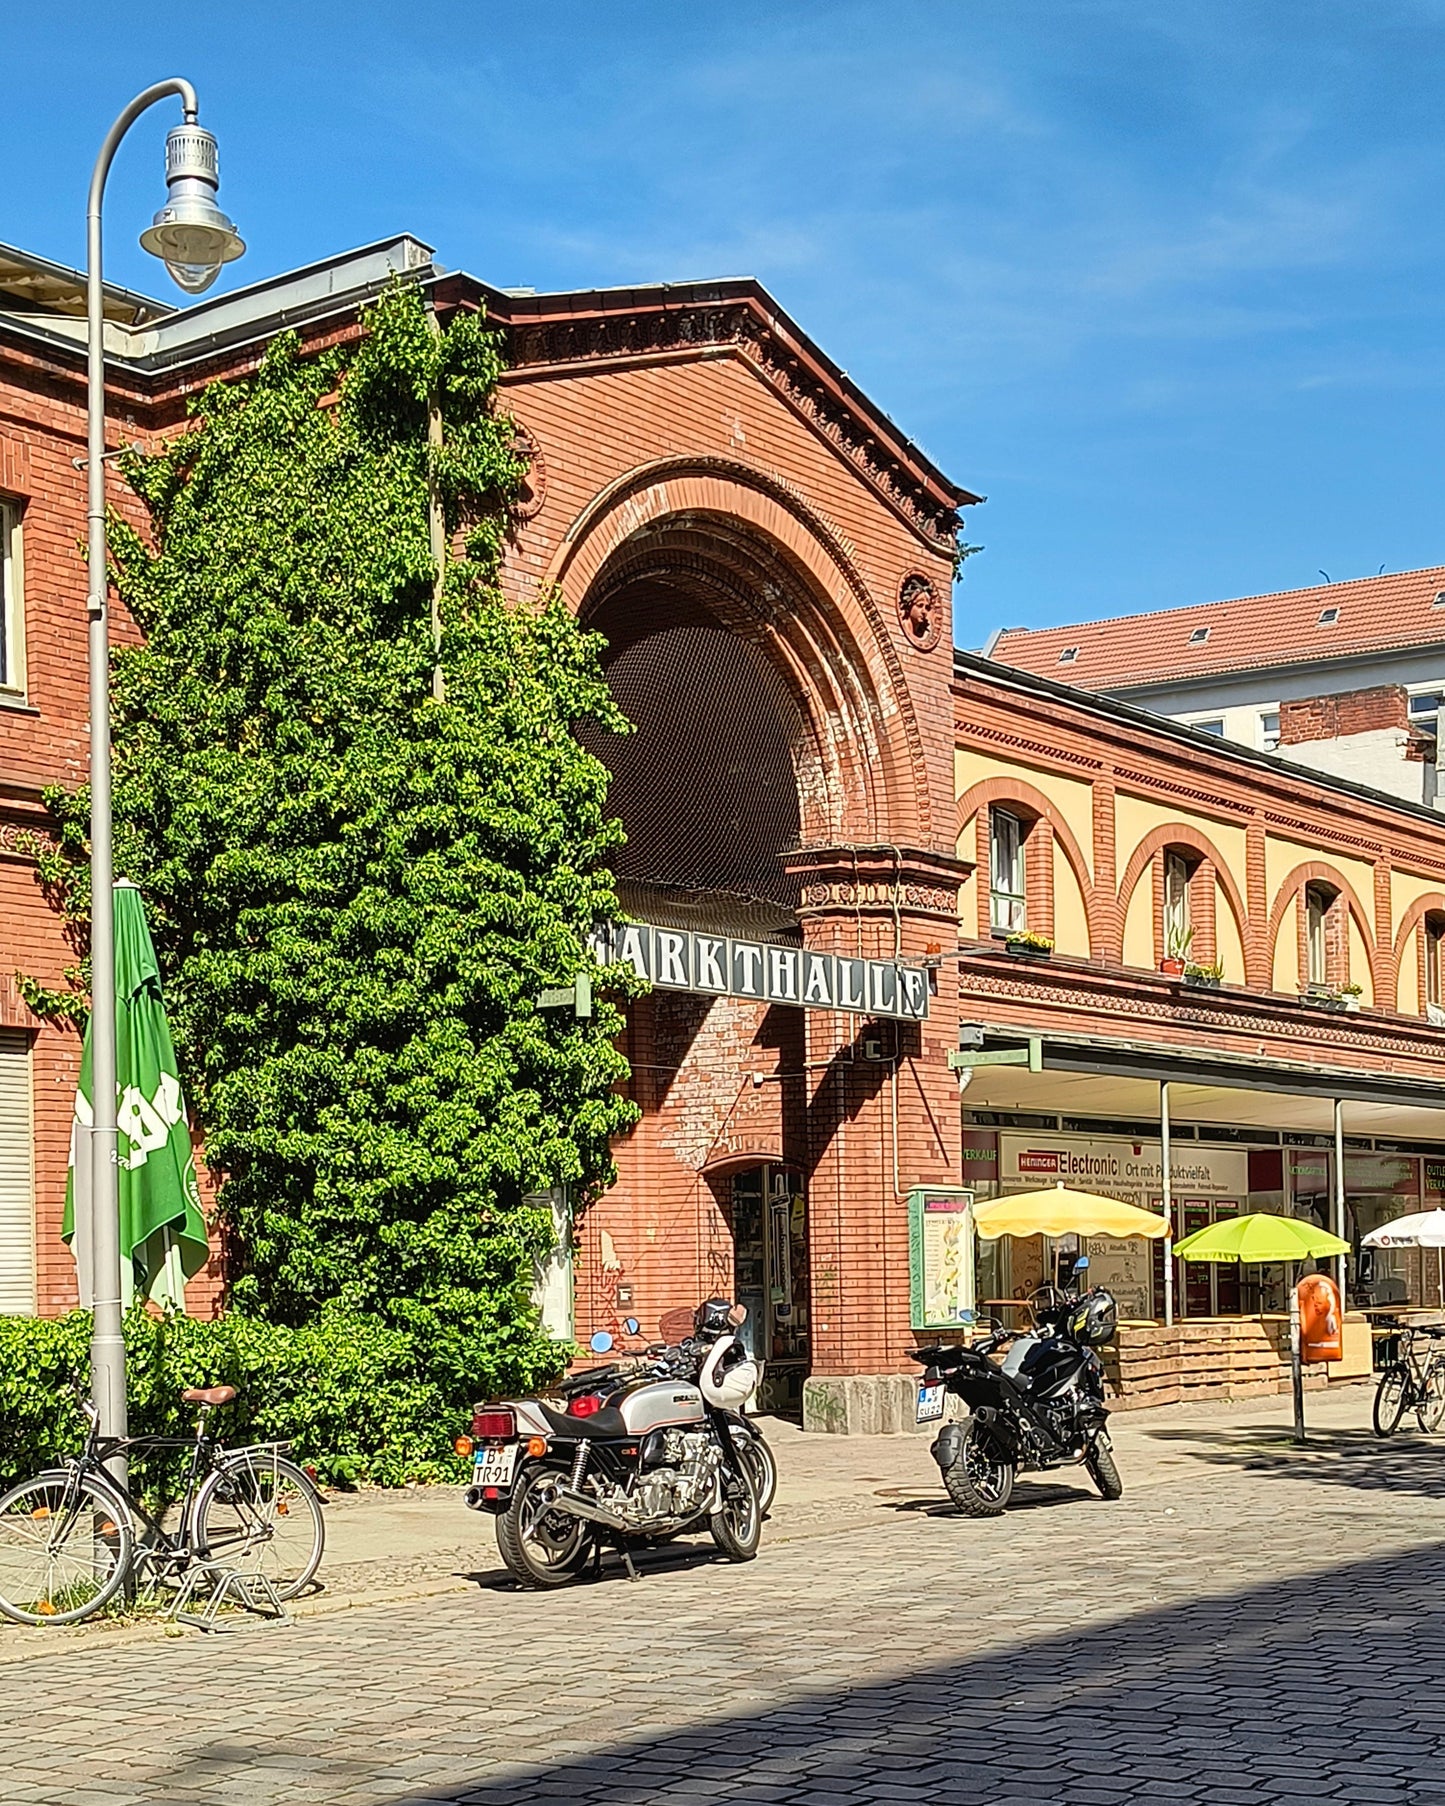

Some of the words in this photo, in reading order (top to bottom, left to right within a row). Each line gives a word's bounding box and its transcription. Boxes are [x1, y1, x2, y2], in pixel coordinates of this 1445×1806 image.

[1059, 1151, 1118, 1177] Electronic
[1125, 1162, 1139, 1177] Ort
[1140, 1163, 1154, 1178] mit
